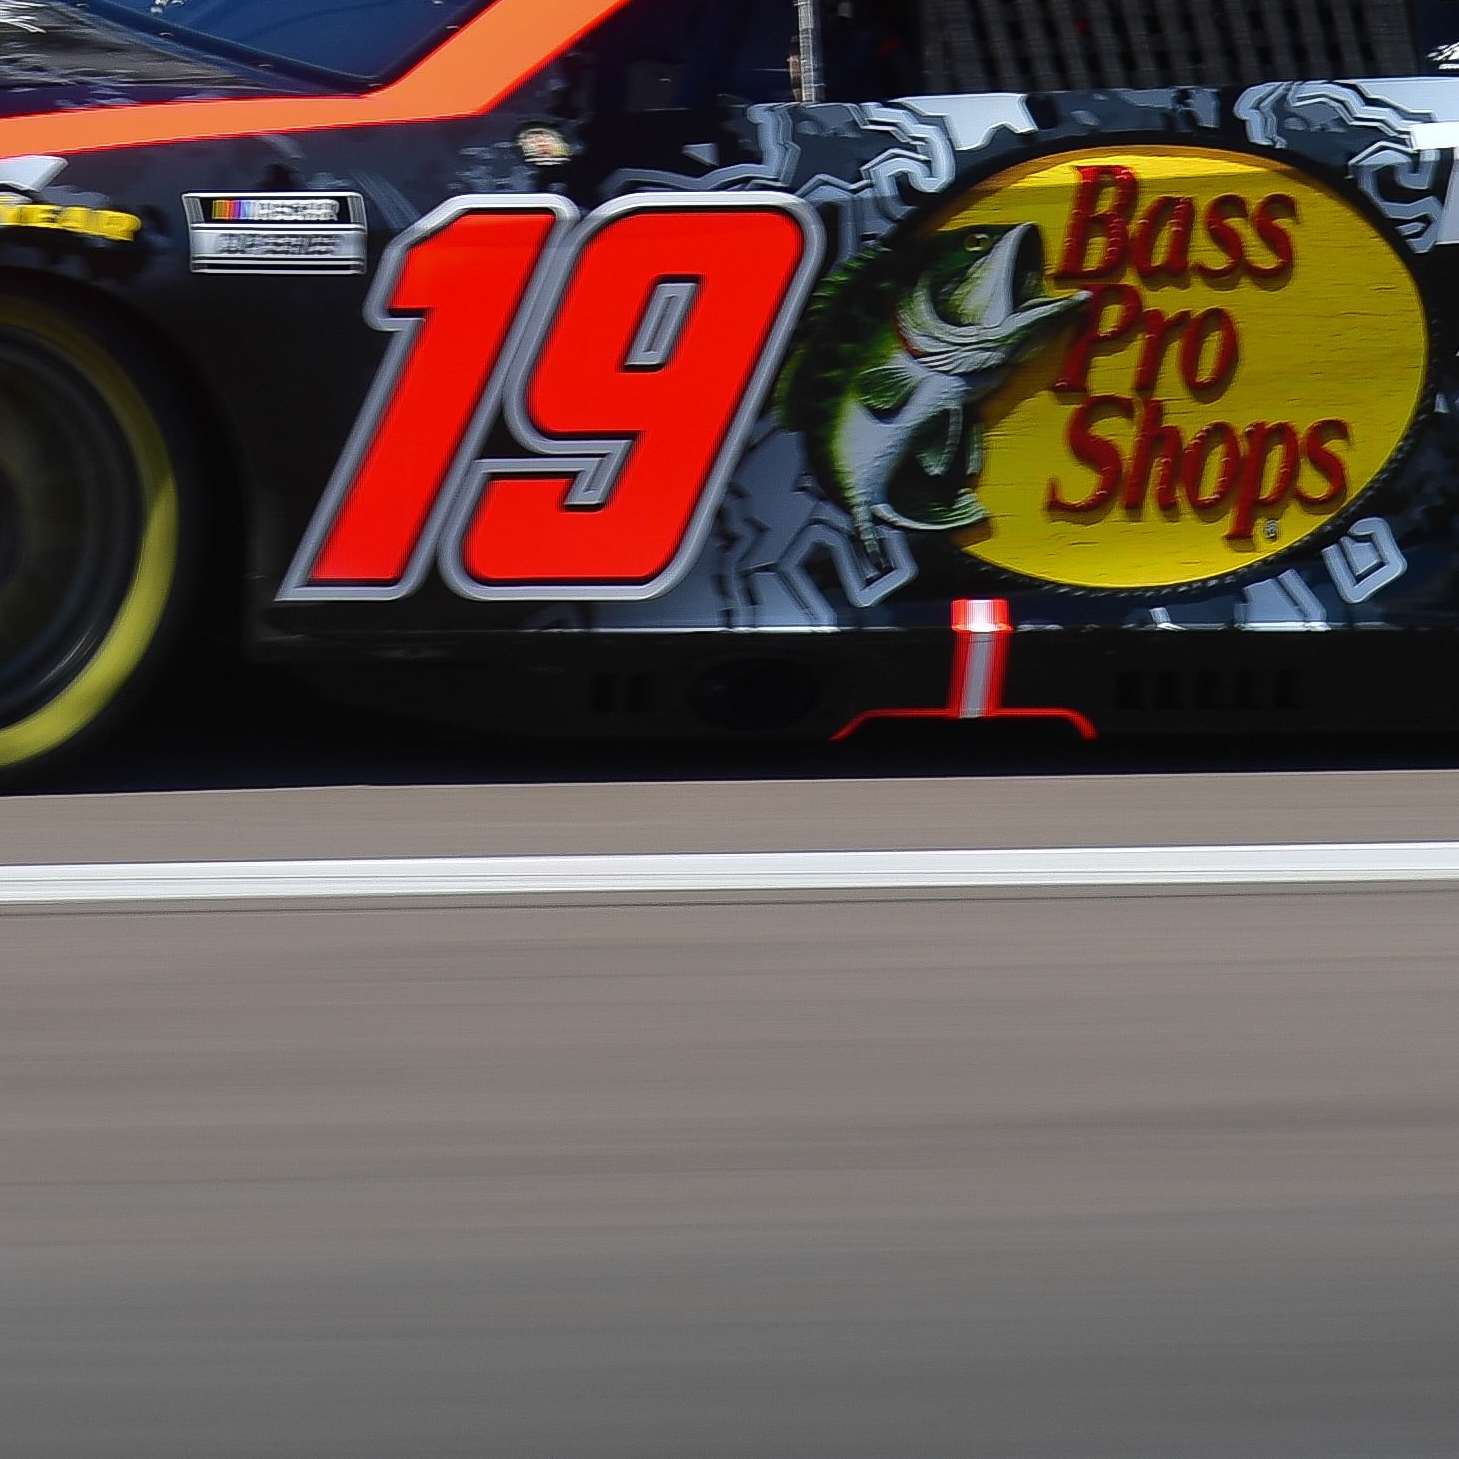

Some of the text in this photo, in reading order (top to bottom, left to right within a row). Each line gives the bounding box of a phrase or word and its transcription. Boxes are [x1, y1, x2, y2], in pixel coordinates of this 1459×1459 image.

[1047, 164, 1301, 280] Bass
[274, 191, 828, 602] 19
[1050, 282, 1240, 393] Pro
[1046, 393, 1354, 542] Shops
